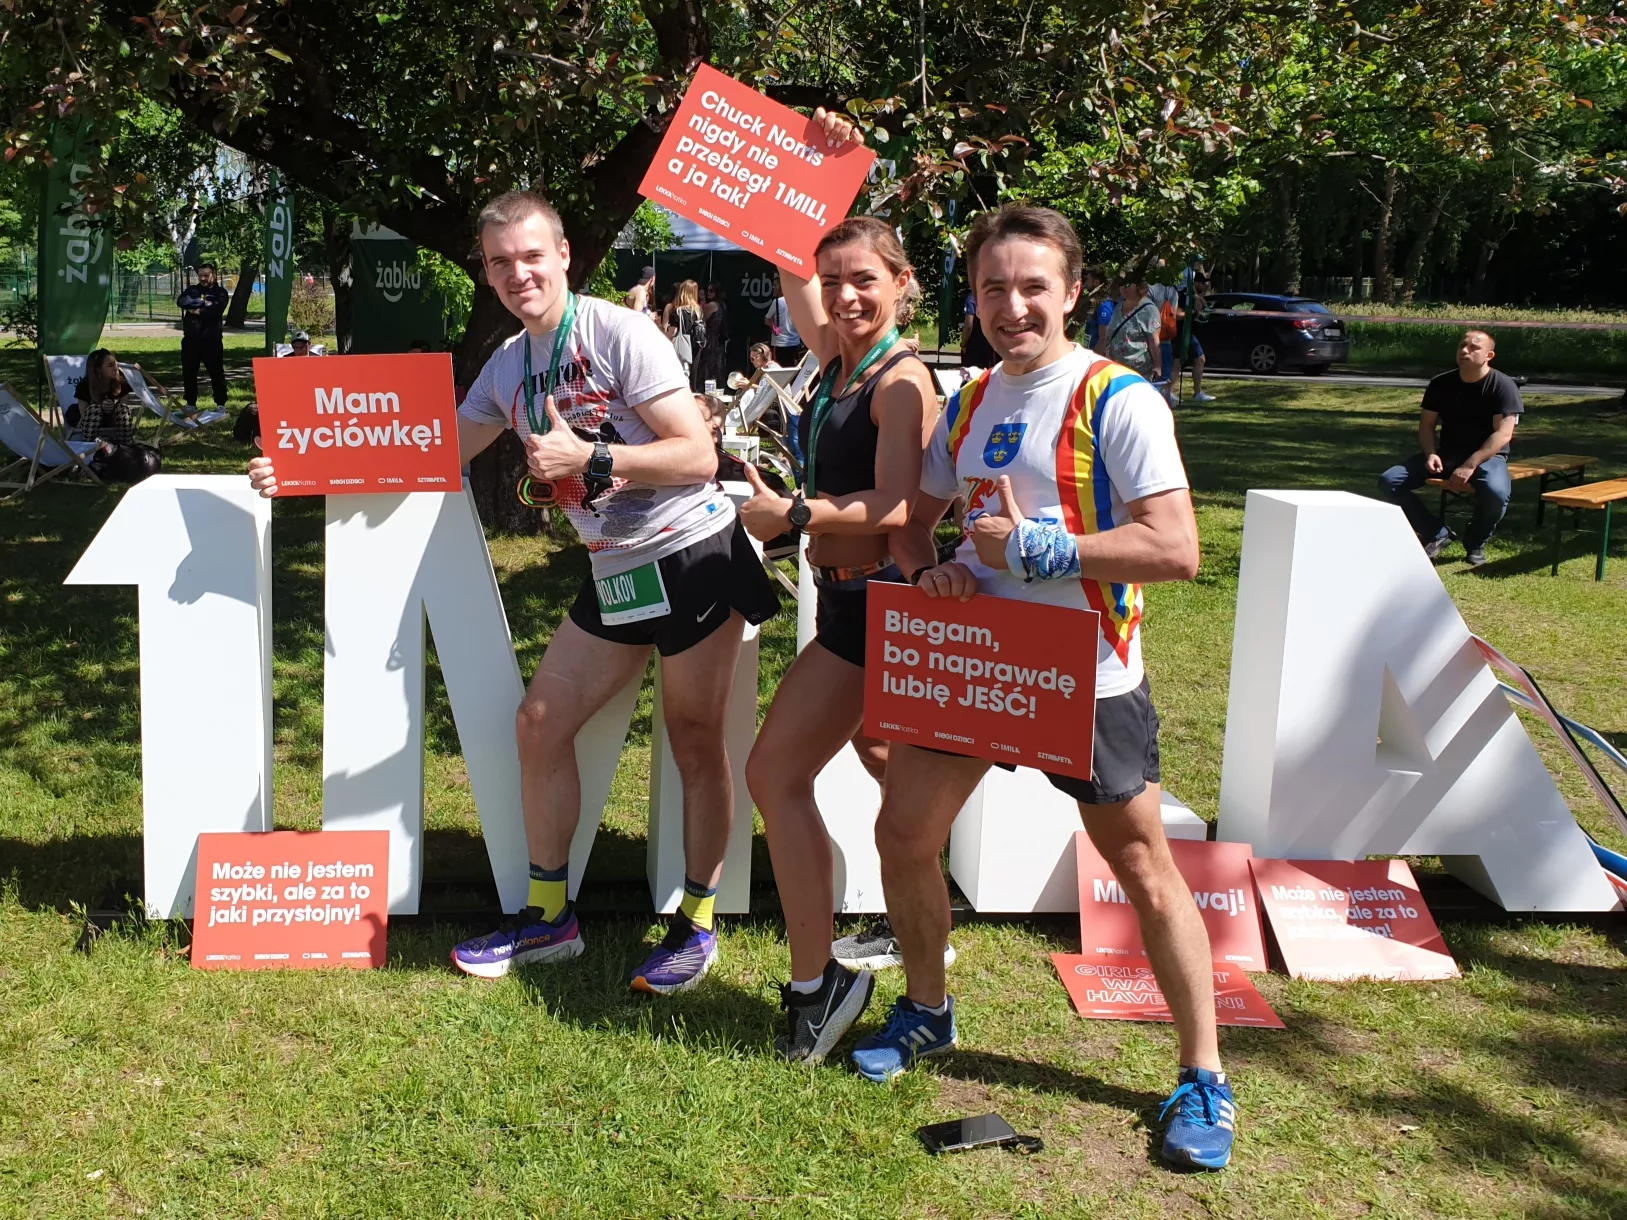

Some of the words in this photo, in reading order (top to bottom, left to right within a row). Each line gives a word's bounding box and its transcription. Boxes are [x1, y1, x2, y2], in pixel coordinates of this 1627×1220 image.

[688, 114, 746, 155] nigdy
[747, 145, 778, 170] nie
[701, 90, 766, 137] Chuck
[767, 125, 824, 166] Norris
[668, 158, 684, 175] a
[683, 164, 708, 188] ja
[710, 176, 751, 209] tak!
[676, 135, 771, 193] przebiegł
[775, 182, 827, 227] 1MILI,
[315, 387, 400, 415] Mam
[277, 417, 442, 454] życiówkę!
[885, 609, 1000, 653] Biegam,
[884, 640, 920, 667] bo
[928, 651, 1076, 699] naprawdę
[882, 671, 950, 708] lubię
[958, 683, 1036, 719] JEŚĆ!
[212, 861, 265, 880] Może
[270, 861, 301, 879] nie
[306, 860, 374, 882] jestem
[210, 883, 278, 905] szybki,
[283, 883, 316, 901] ale
[321, 885, 345, 900] za
[349, 882, 370, 899] to
[1271, 885, 1316, 902] Może
[1319, 886, 1345, 901] nie
[1348, 887, 1406, 905] jestem
[208, 905, 247, 927] jaki
[252, 904, 360, 926] przystojny!
[1345, 905, 1373, 920] ale
[1375, 907, 1397, 919] za
[1398, 904, 1418, 919] to
[493, 942, 512, 956] new
[1075, 964, 1155, 979] GIRLS
[1086, 990, 1167, 1005] HAVE
